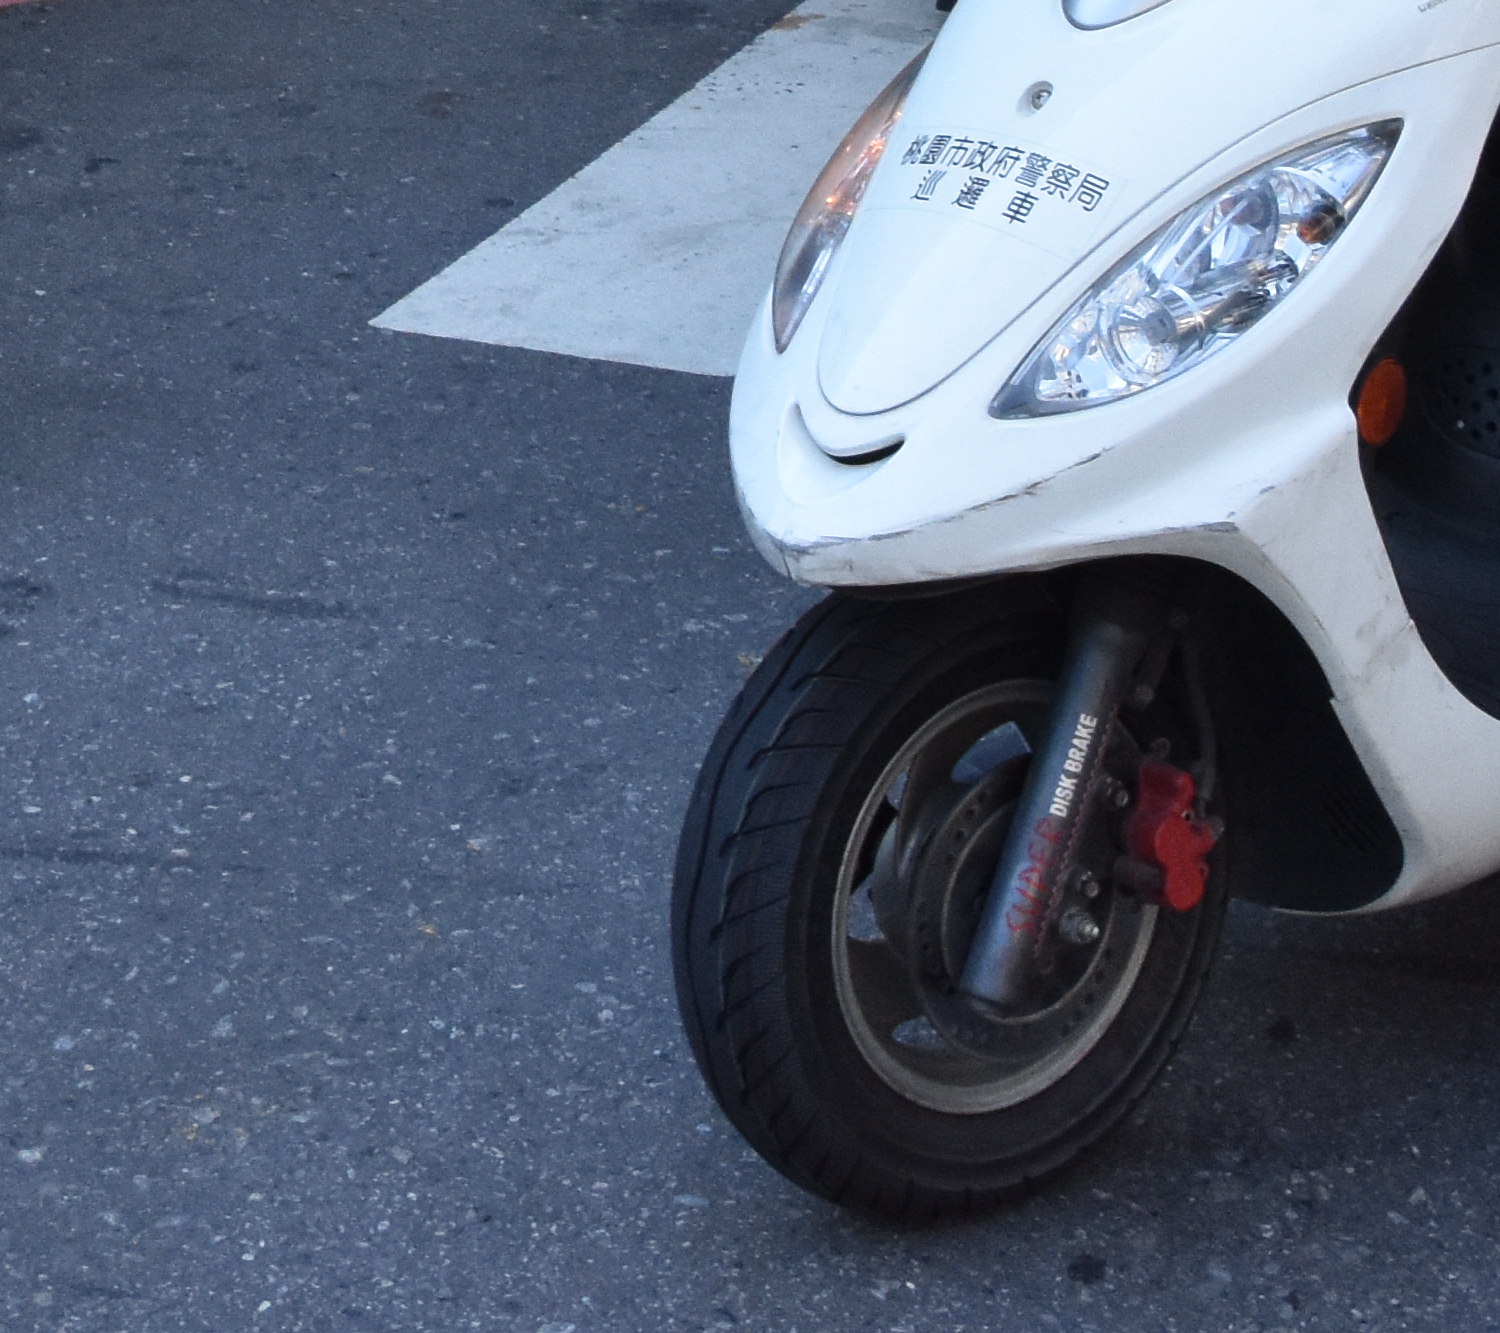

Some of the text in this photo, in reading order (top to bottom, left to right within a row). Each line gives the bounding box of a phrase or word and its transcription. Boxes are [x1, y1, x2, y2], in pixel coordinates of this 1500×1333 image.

[900, 134, 1110, 213] 桃園市政府警察局
[909, 168, 1040, 224] 巡邏車
